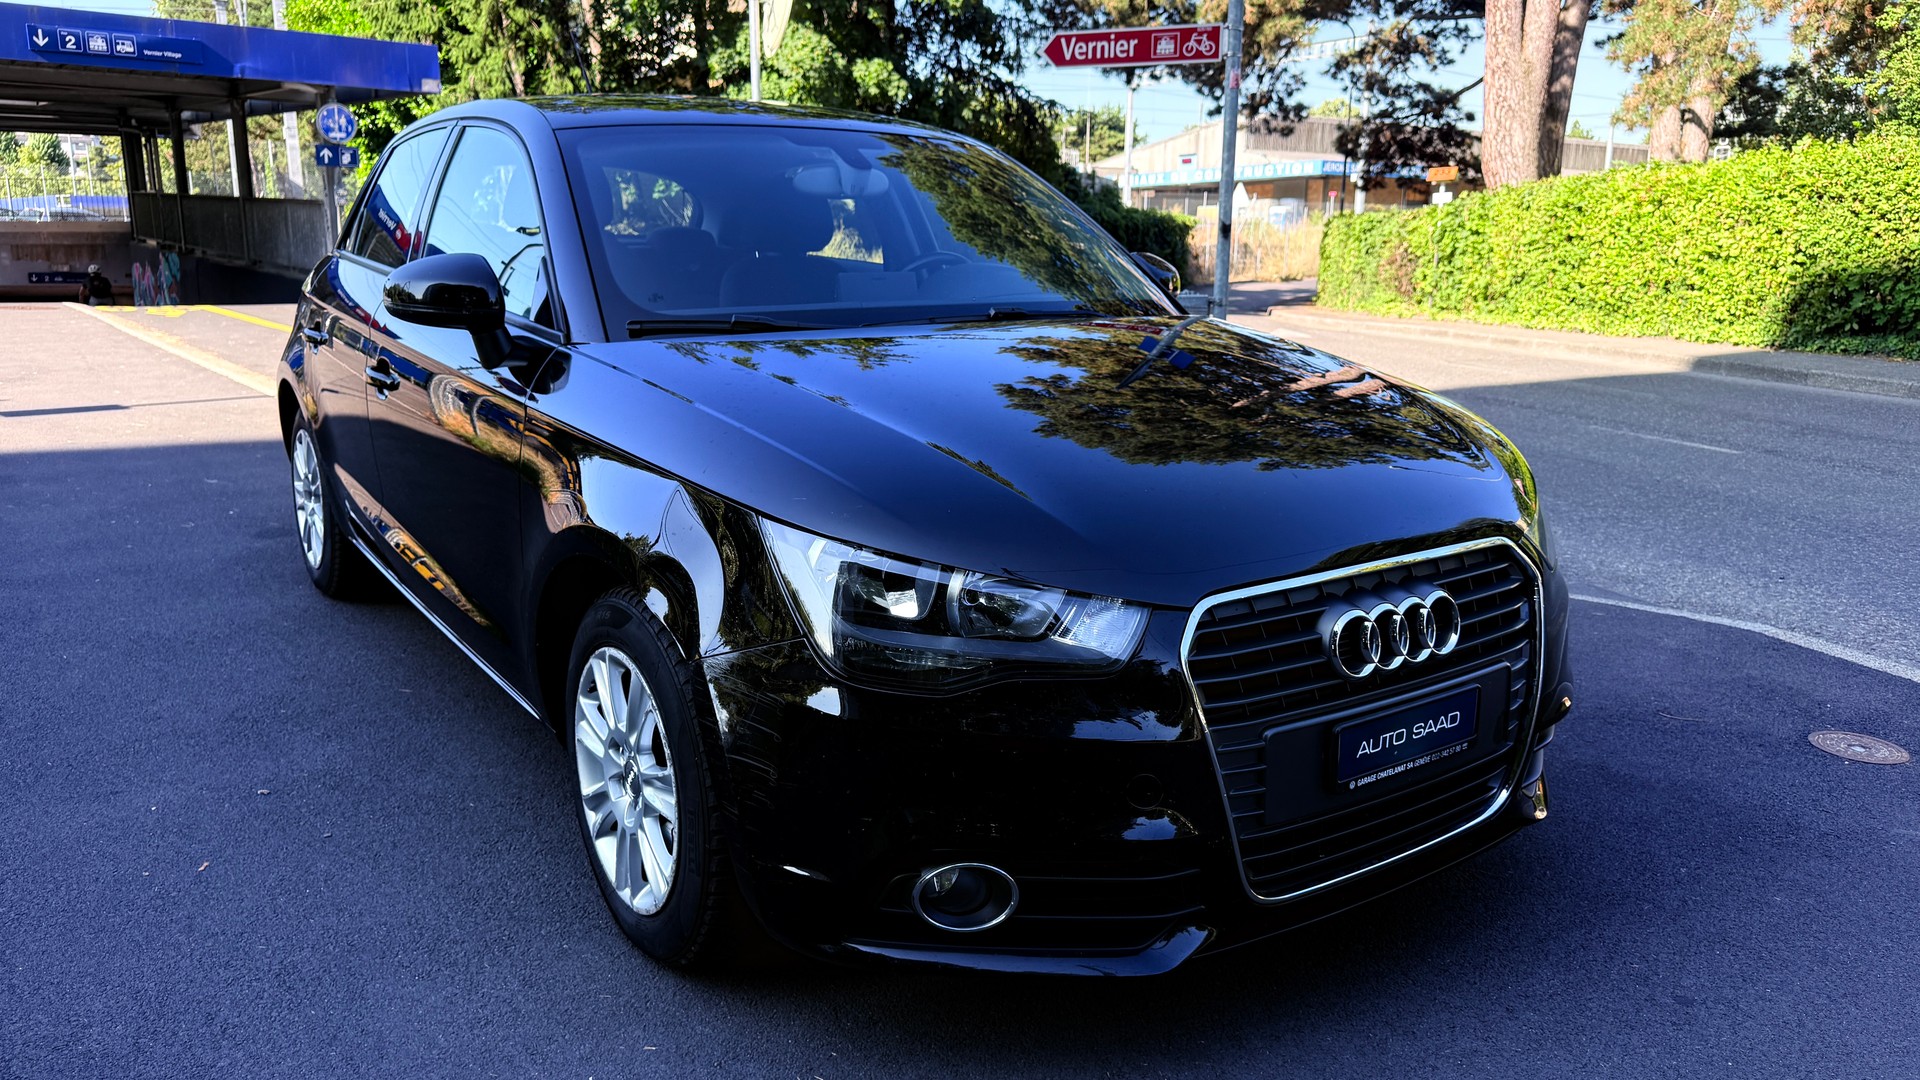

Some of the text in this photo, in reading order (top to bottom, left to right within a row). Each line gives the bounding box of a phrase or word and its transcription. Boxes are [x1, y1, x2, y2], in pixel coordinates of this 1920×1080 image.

[65, 35, 76, 49] 2
[1060, 34, 1139, 61] Vernier
[143, 49, 182, 59] Vernier Village
[1195, 161, 1314, 181] CONTRUCTION
[1356, 711, 1460, 758] AUTO SAAD
[1357, 773, 1377, 787] GARAGE
[1377, 763, 1407, 780] CHATELANAT
[1406, 761, 1414, 770] SA
